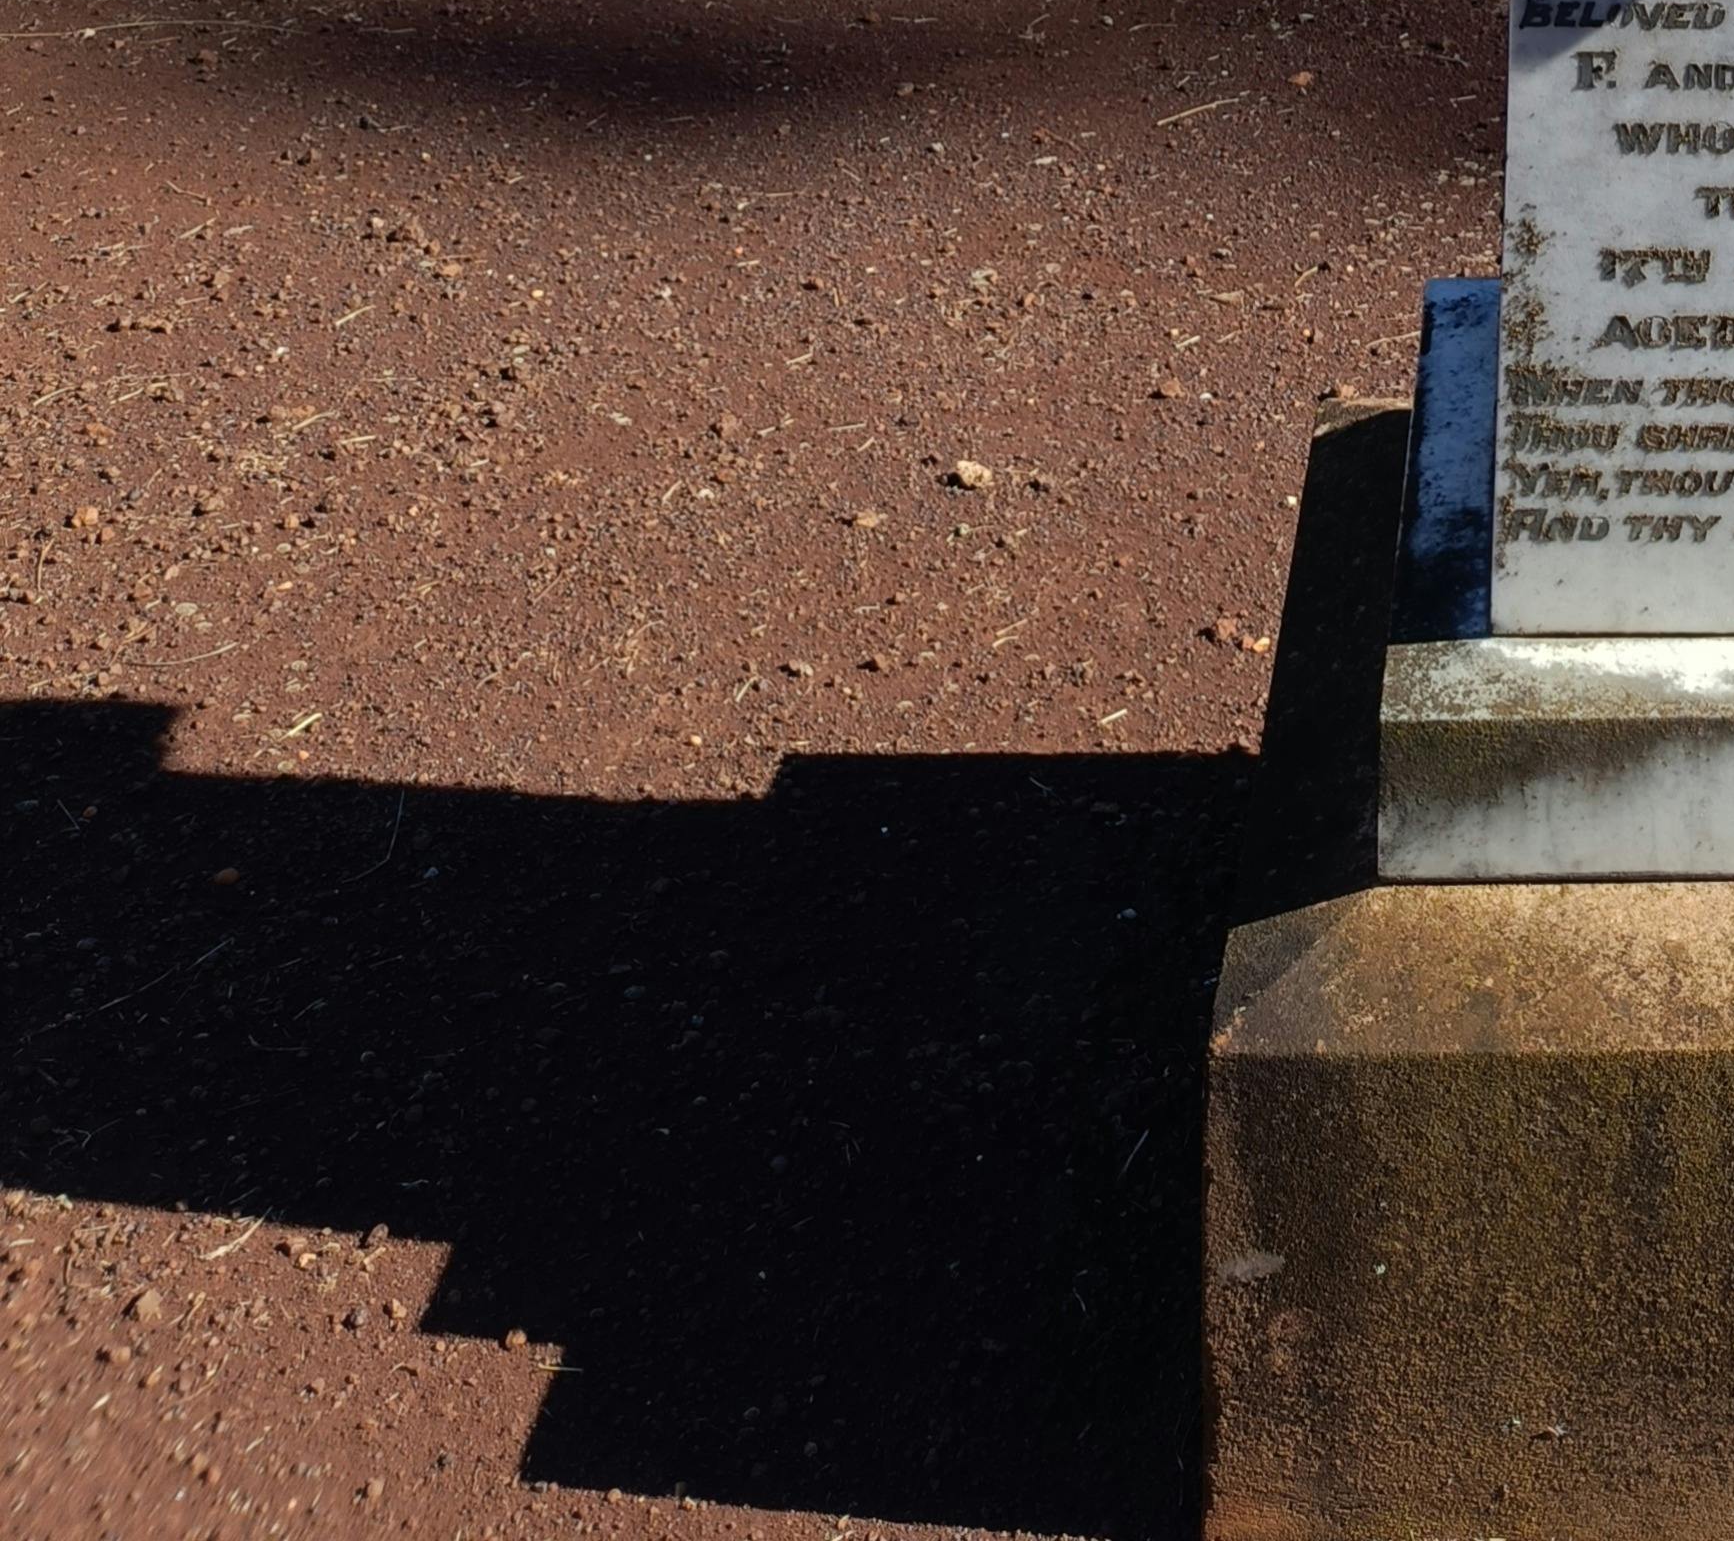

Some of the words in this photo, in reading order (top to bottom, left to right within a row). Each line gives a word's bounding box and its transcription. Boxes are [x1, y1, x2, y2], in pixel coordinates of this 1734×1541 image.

[1504, 367, 1644, 406] WHEN
[1506, 414, 1624, 455] THOU
[1509, 509, 1610, 542] AND
[1623, 515, 1722, 543] THY
